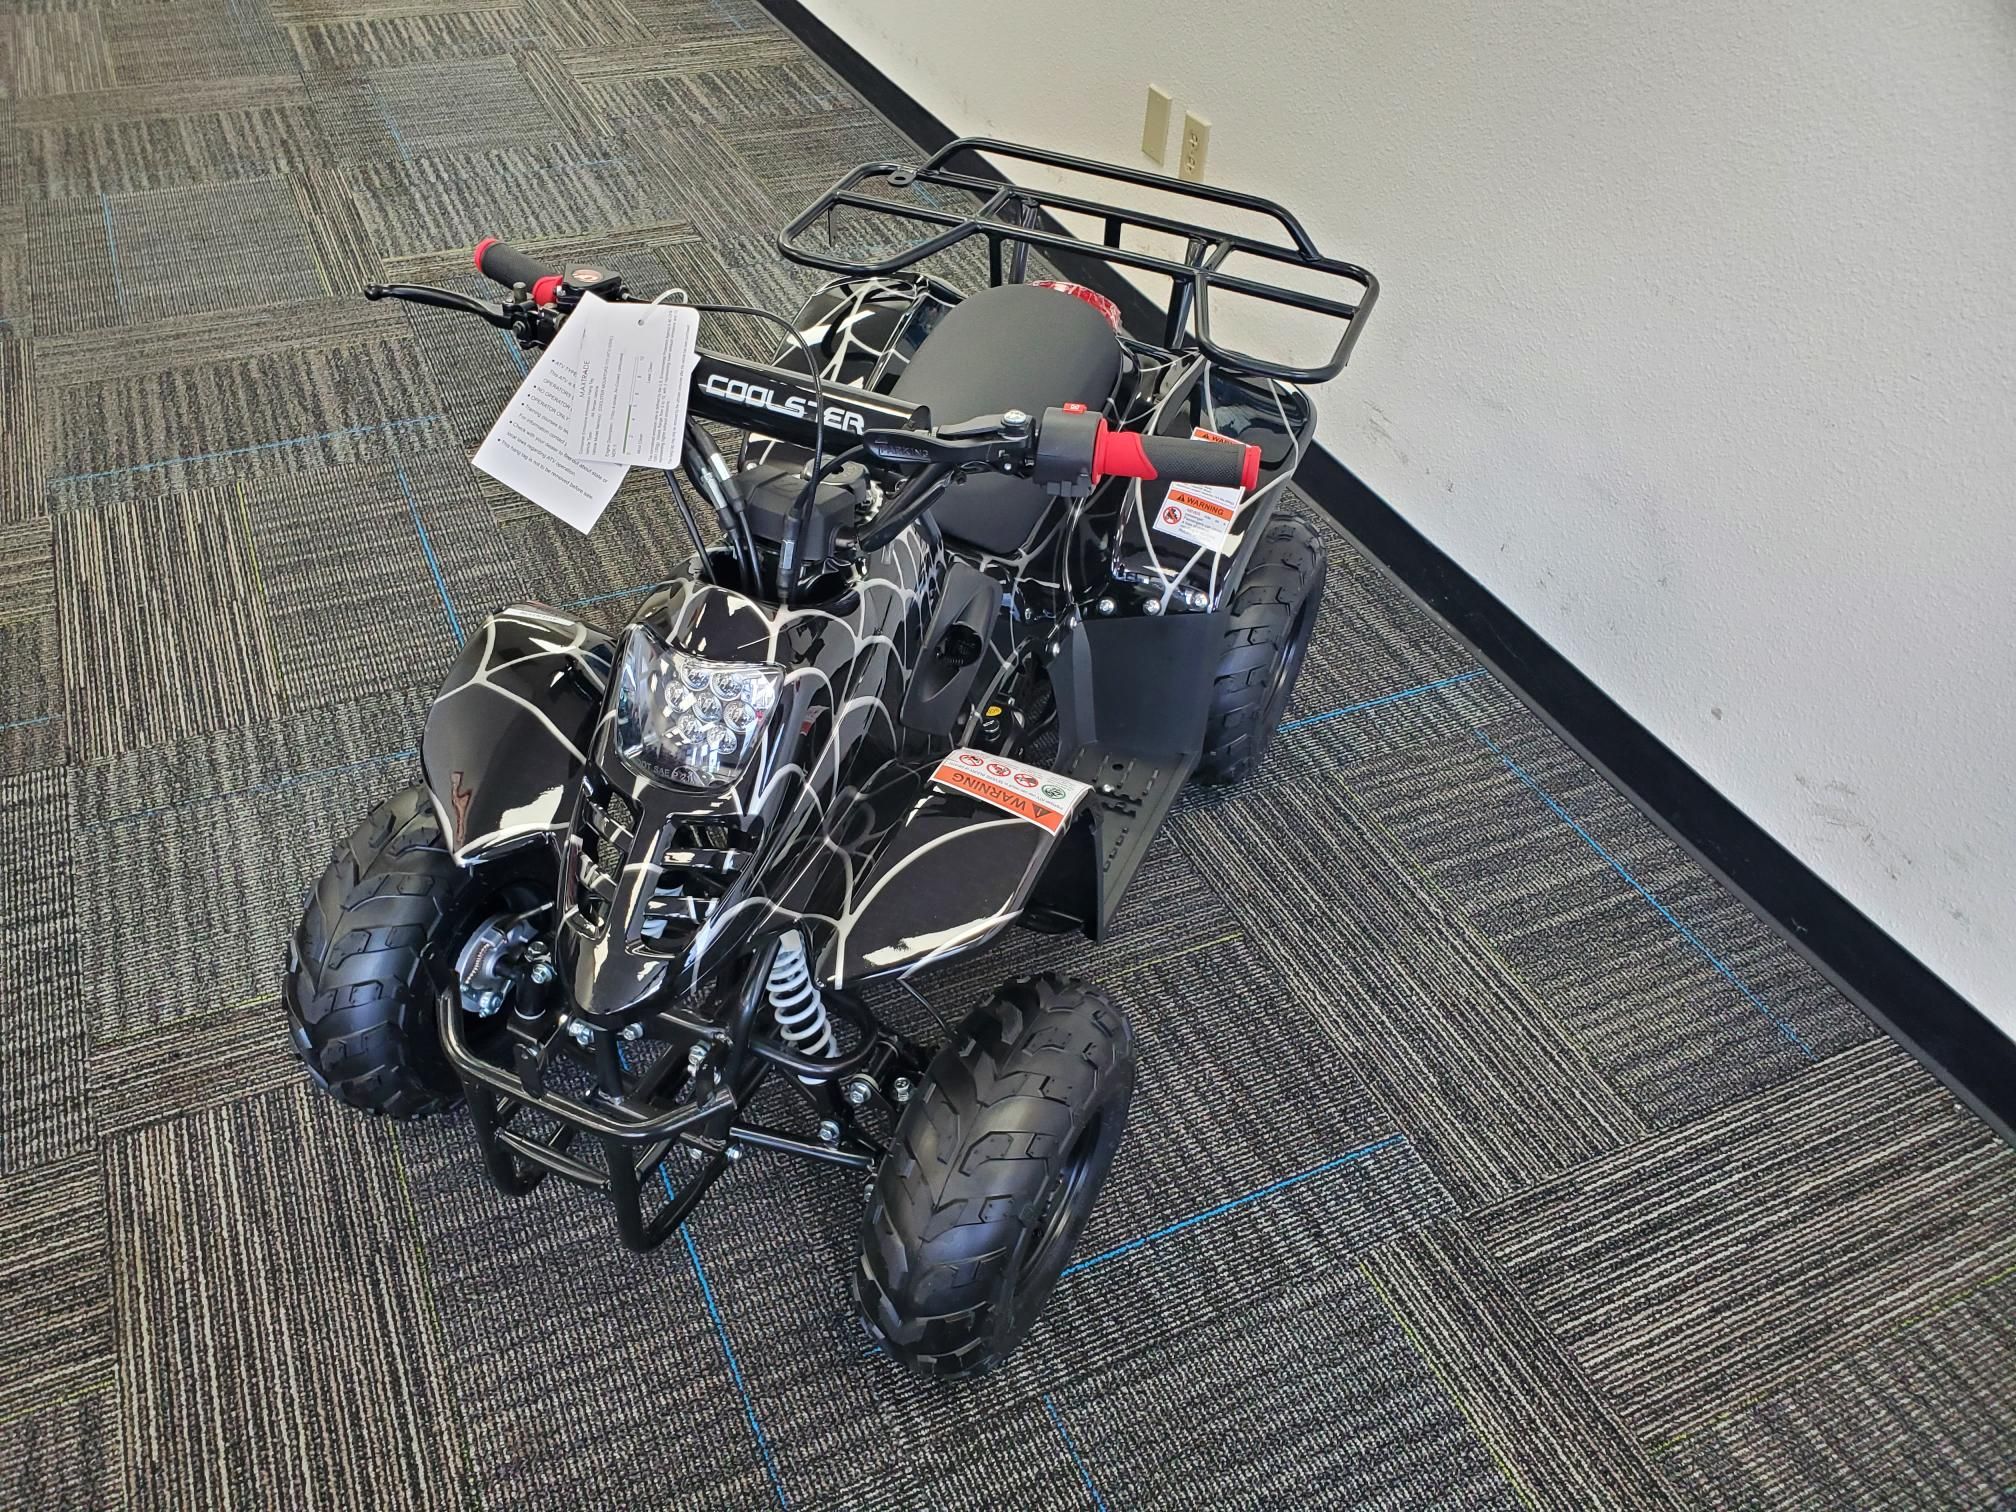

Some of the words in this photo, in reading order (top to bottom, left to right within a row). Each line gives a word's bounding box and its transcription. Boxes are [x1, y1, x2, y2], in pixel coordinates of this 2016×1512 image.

[579, 360, 589, 397] MAXTRADE
[1187, 497, 1223, 515] WARNING
[952, 773, 1025, 809] WARNING
